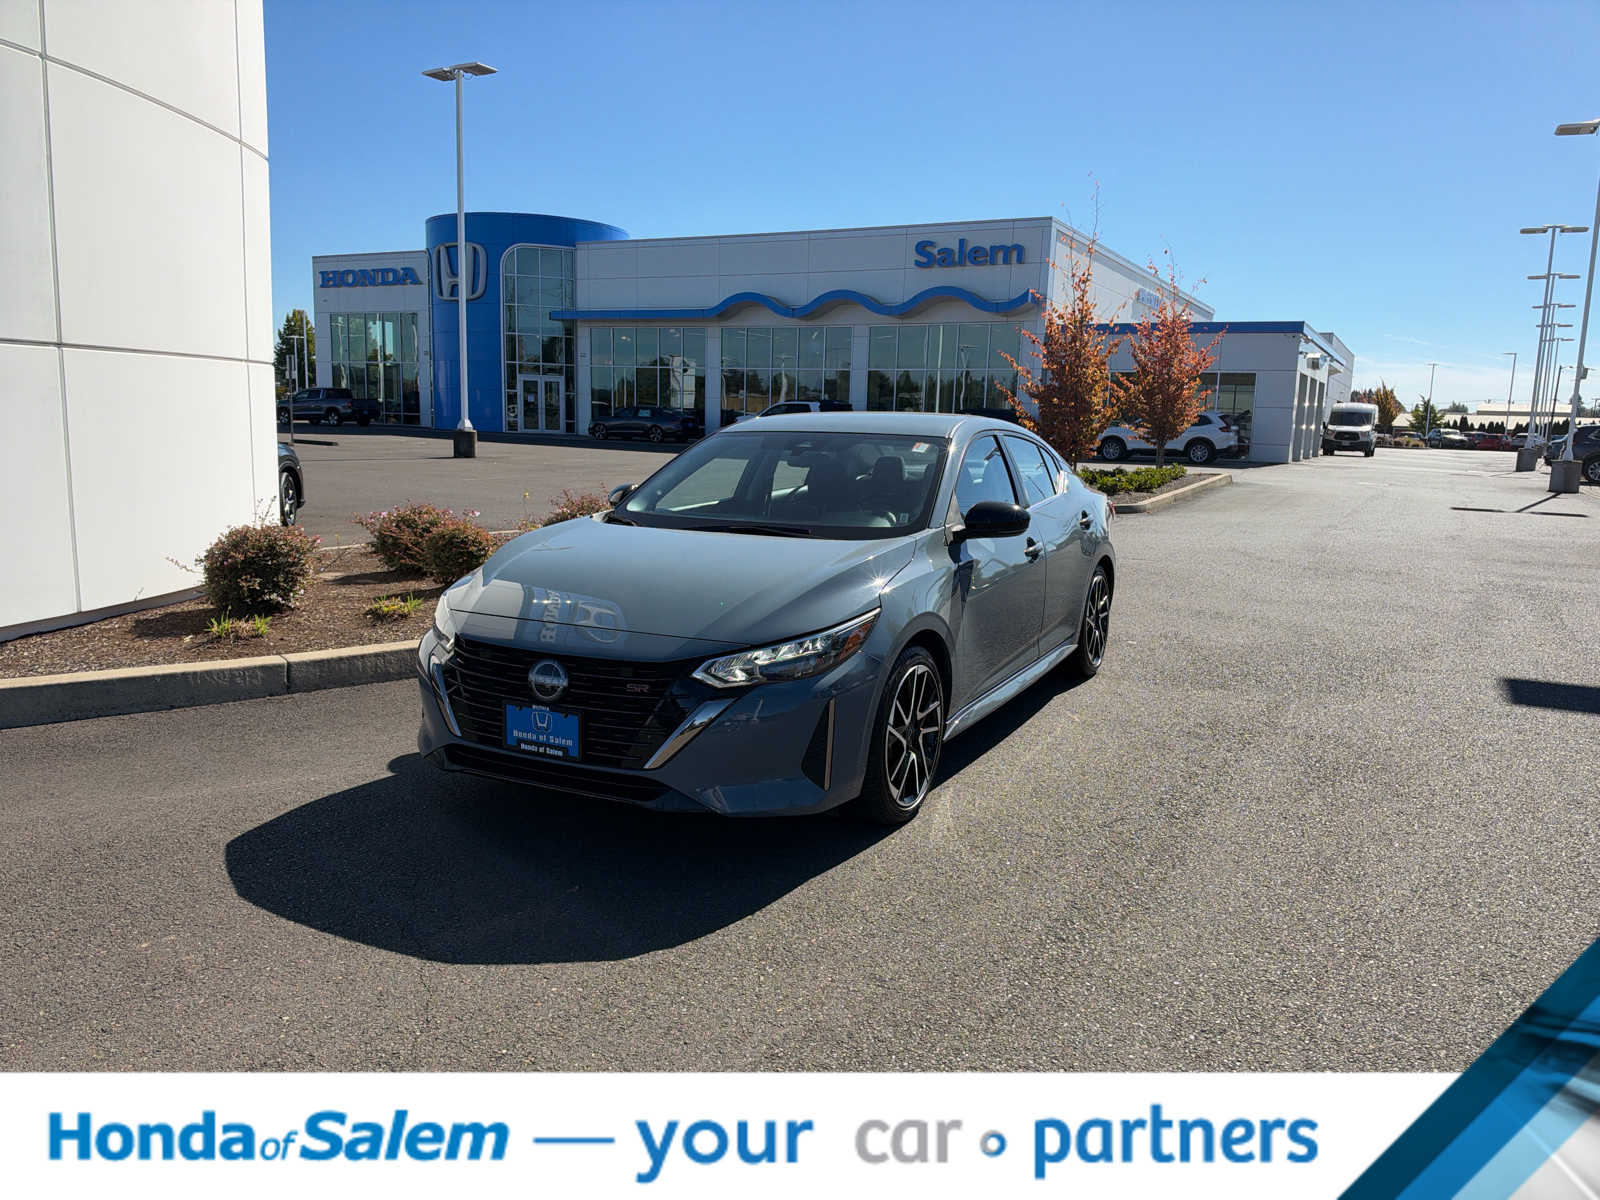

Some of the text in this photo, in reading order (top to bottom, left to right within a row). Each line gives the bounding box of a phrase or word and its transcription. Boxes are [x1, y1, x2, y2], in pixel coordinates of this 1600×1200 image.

[913, 238, 1025, 269] Salem
[319, 267, 424, 288] HONDA
[513, 728, 573, 747] Honda of Salem
[520, 742, 538, 752] Honda
[546, 746, 564, 757] Salem
